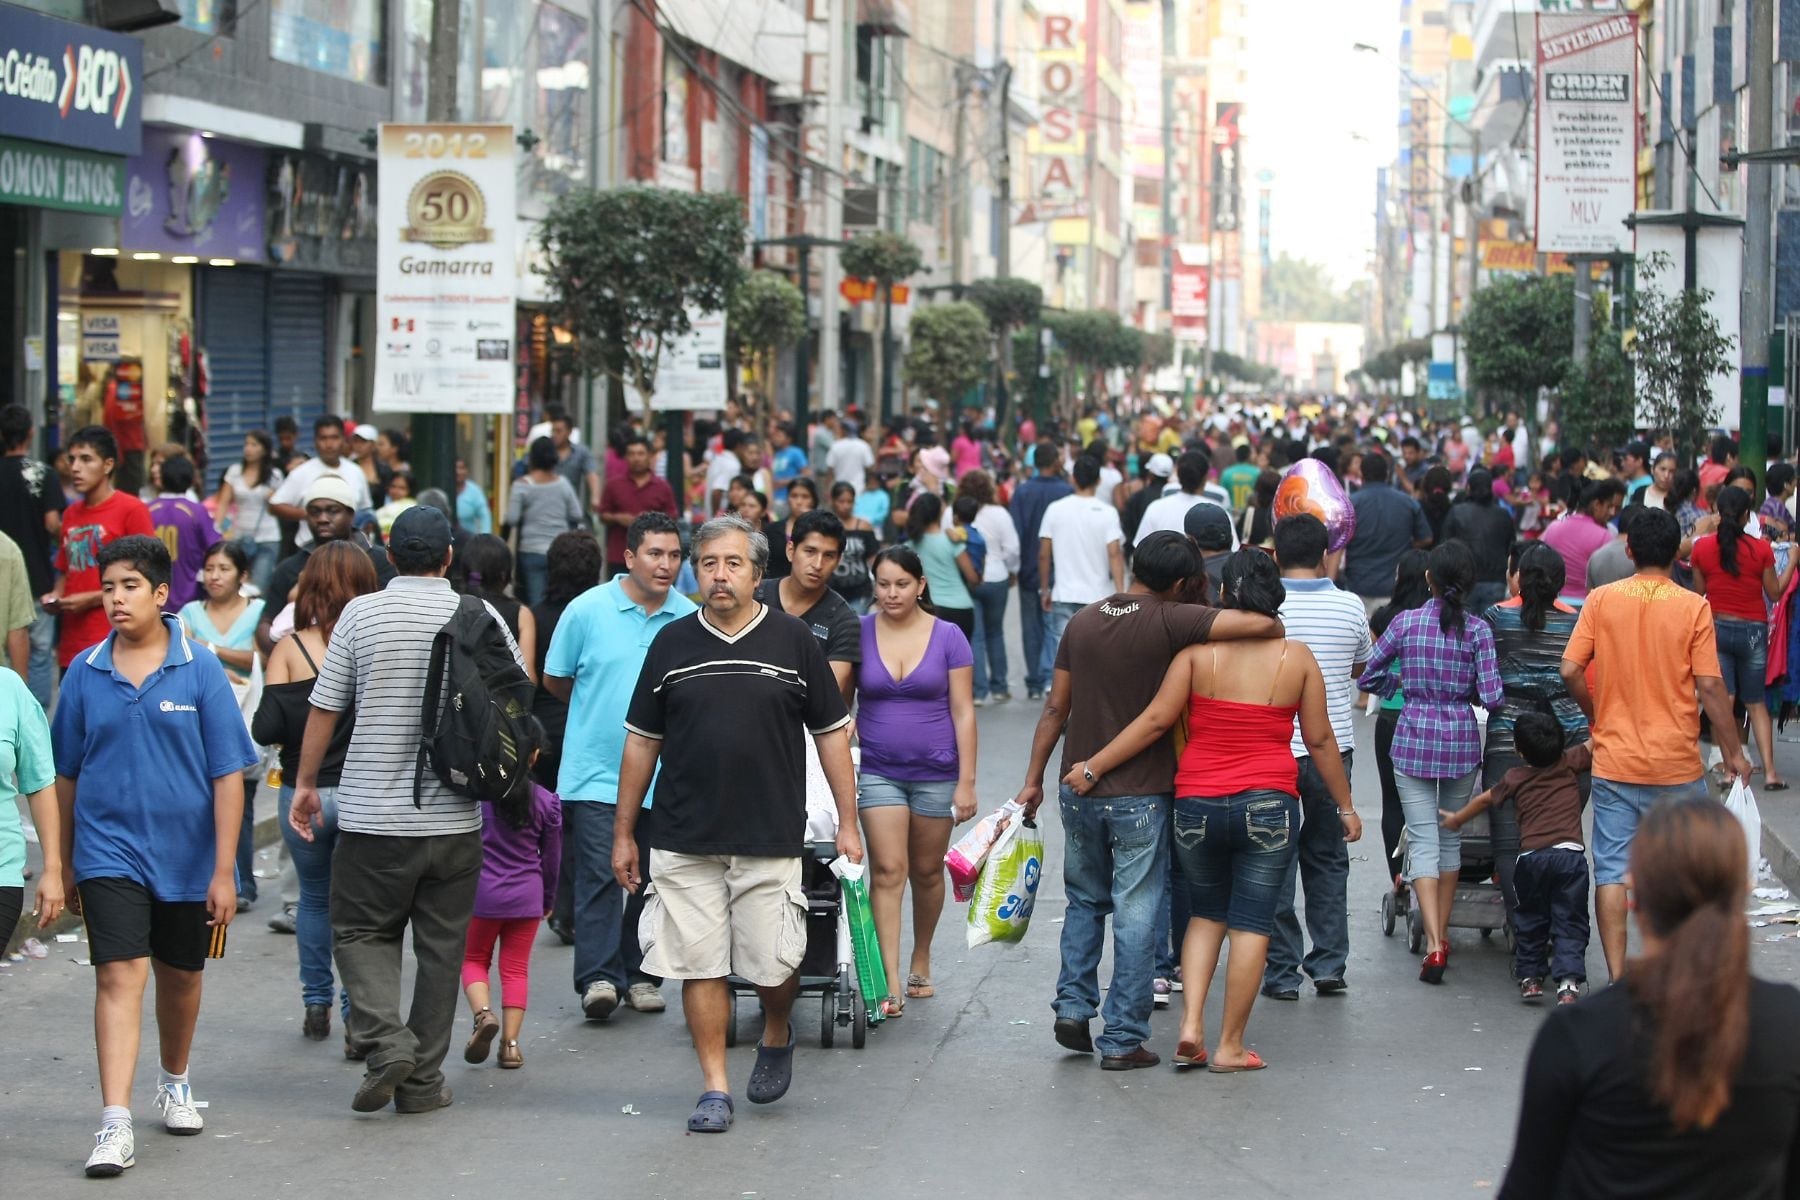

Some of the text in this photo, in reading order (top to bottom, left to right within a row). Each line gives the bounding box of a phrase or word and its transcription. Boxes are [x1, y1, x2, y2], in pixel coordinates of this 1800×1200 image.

[1541, 16, 1633, 60] SETIEMBRE
[5, 48, 58, 103] Crédito
[74, 44, 120, 114] BCP
[1551, 74, 1624, 89] ORDEN
[1043, 15, 1073, 189] ROSA
[404, 132, 488, 159] 2012
[421, 191, 469, 222] 50
[1571, 201, 1602, 224] MLV
[399, 256, 493, 275] Gamarra
